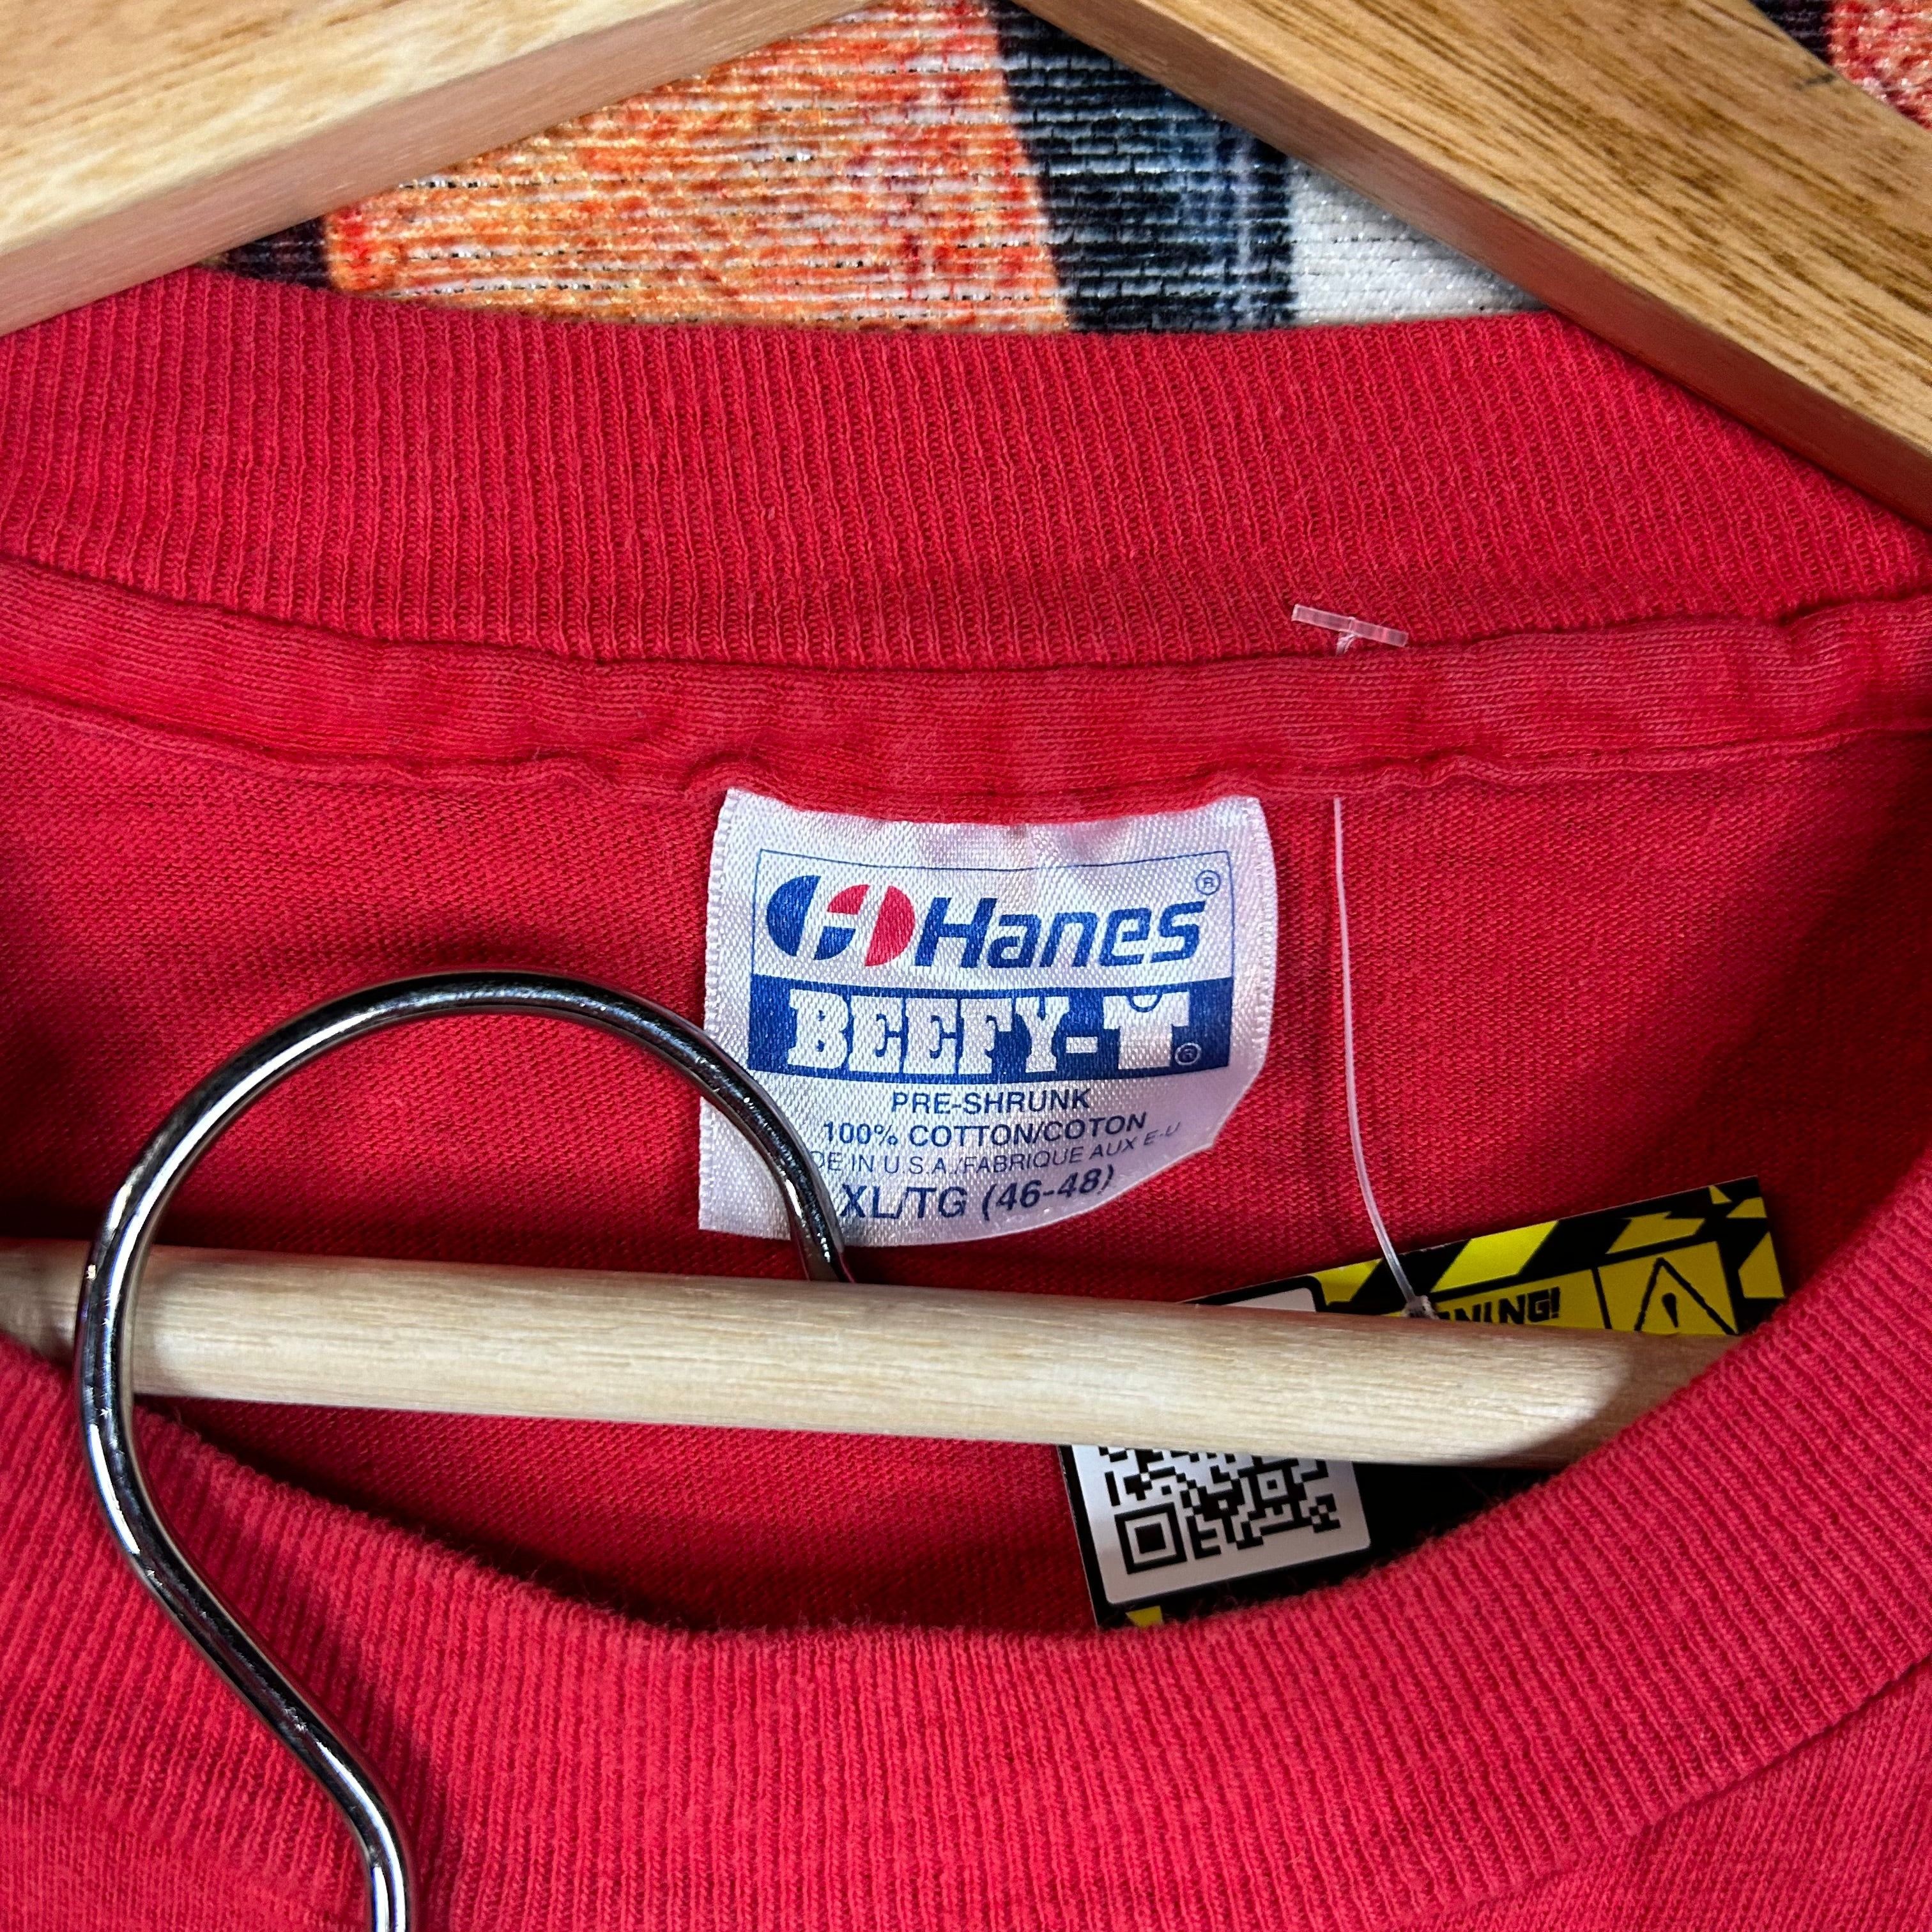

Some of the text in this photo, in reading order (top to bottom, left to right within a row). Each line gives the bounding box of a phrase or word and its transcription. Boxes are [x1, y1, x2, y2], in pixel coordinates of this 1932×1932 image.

[915, 897, 1206, 968] Hanes
[891, 1088, 1091, 1115] PRE-SHRUNK
[824, 1112, 1147, 1147] 100% COTTON/COTON
[810, 1150, 843, 1171] DE
[851, 1153, 874, 1173] IN
[1089, 1137, 1138, 1160] AUX
[840, 1164, 1114, 1221] XL/TG (46-48)
[1438, 1285, 1561, 1324] NING!
